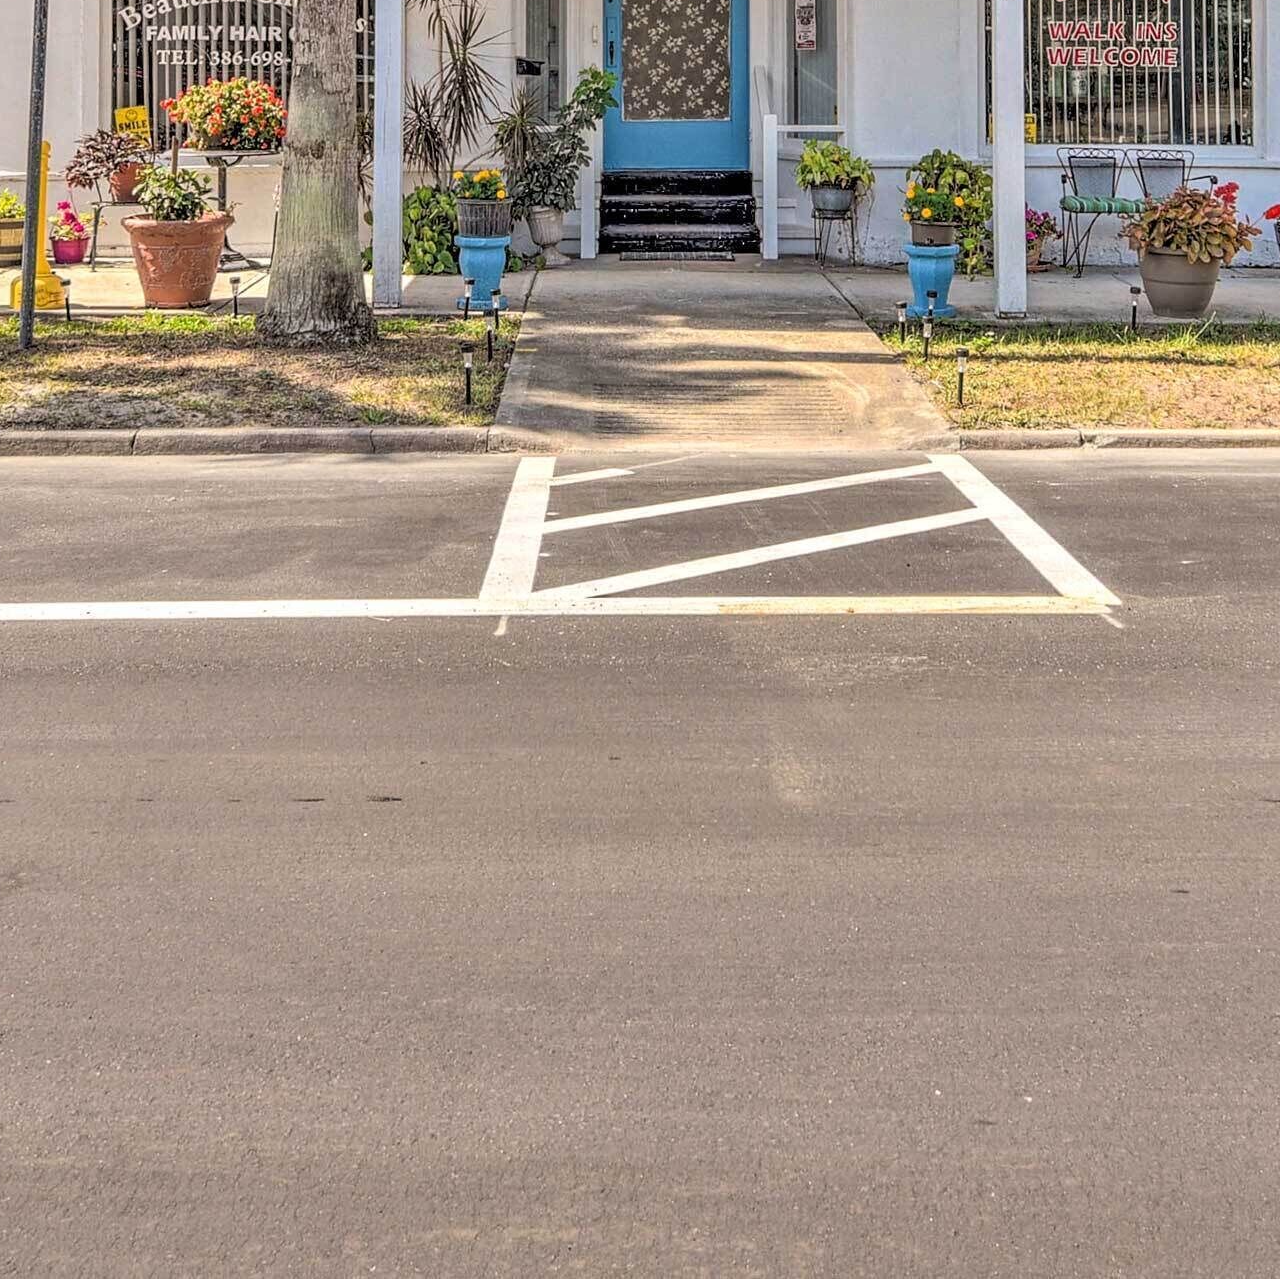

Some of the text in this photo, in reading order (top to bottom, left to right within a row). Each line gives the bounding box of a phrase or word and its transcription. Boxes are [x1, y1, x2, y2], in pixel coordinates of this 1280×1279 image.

[146, 25, 225, 42] FAMILY
[229, 25, 283, 42] HAIR
[1047, 20, 1179, 41] WALK INS
[156, 49, 292, 67] TEL: 386-698-
[1046, 46, 1179, 67] WELCOME
[118, 120, 148, 132] SMILE
